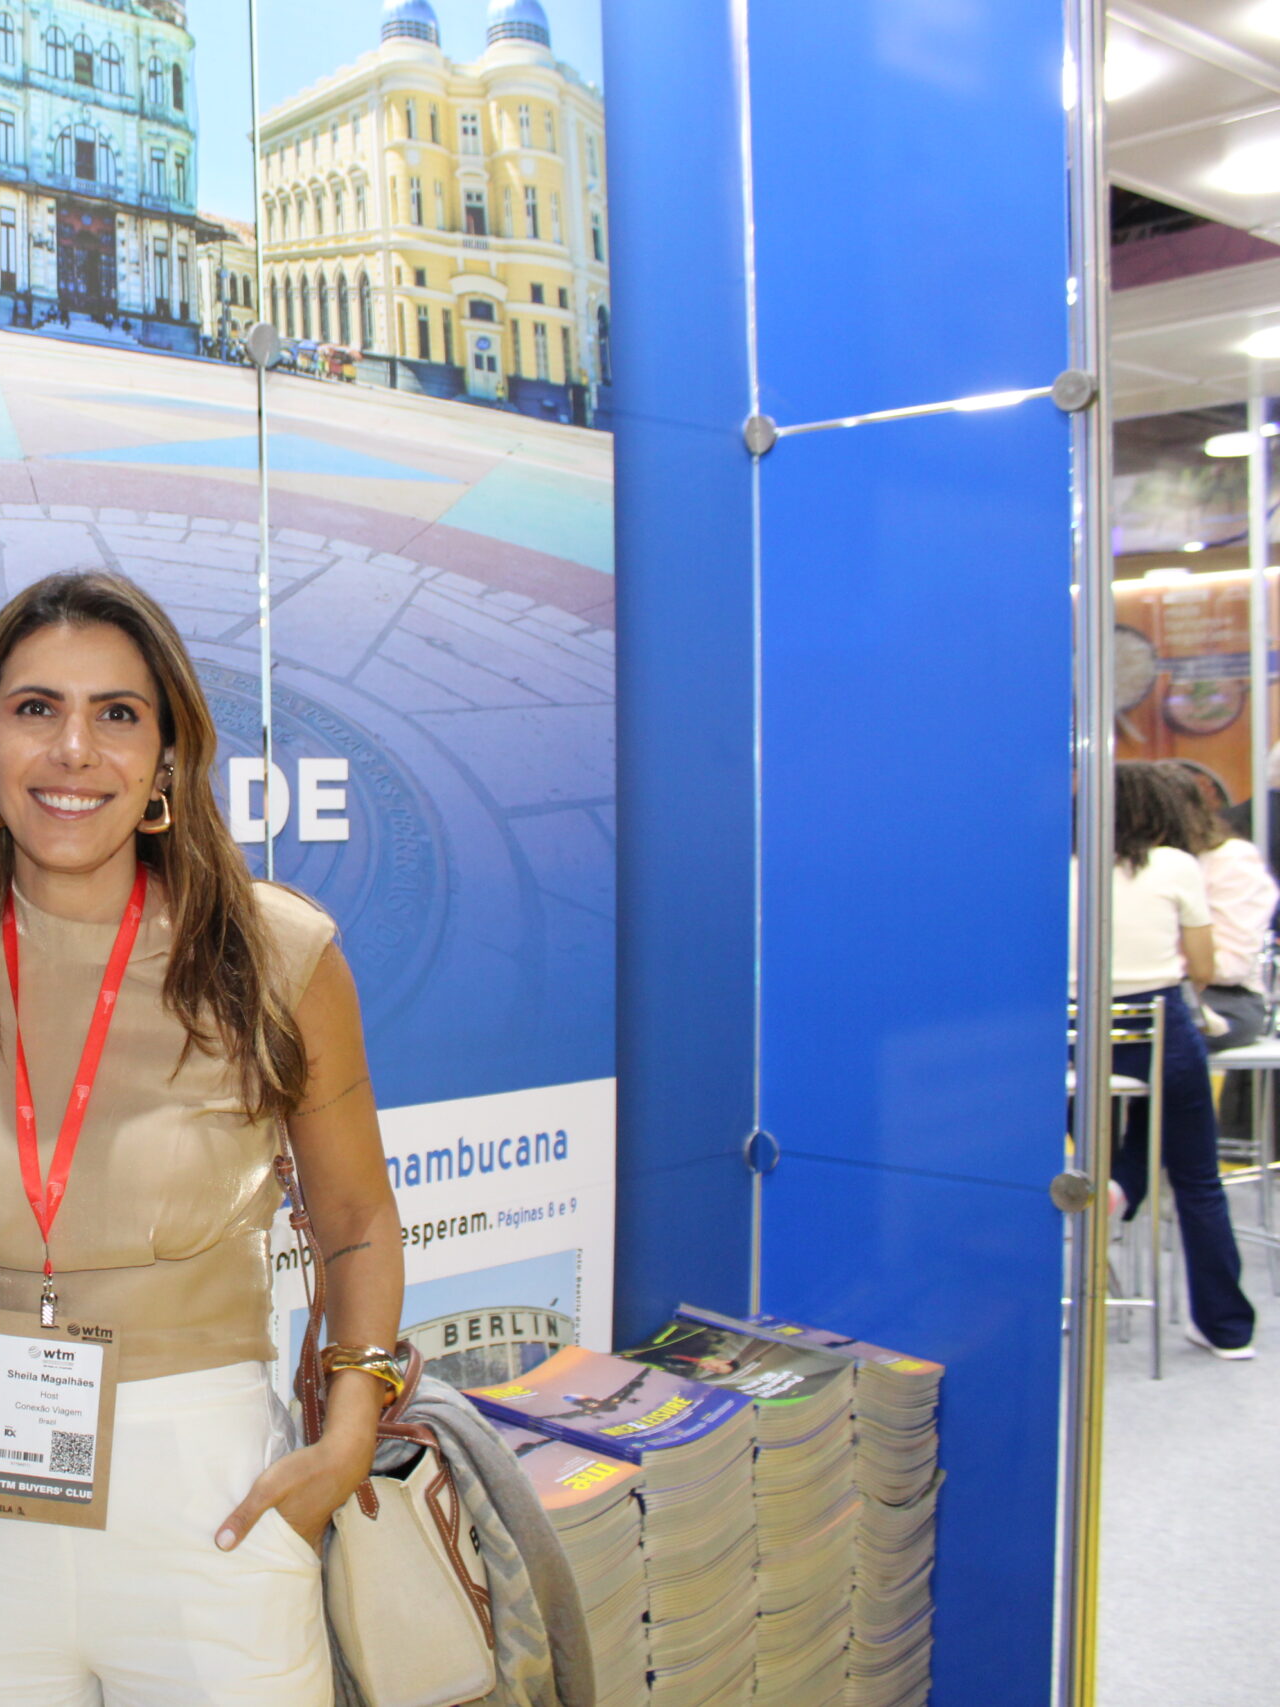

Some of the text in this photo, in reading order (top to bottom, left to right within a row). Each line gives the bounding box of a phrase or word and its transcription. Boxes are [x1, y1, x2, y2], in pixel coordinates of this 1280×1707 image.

[229, 757, 350, 843] DE
[386, 1129, 568, 1188] nambucana
[497, 1206, 544, 1230] Páginas
[548, 1201, 555, 1218] 8
[559, 1203, 566, 1215] e
[570, 1197, 577, 1214] 9
[82, 1325, 113, 1338] wtm
[444, 1315, 559, 1347] BERLIN
[43, 1349, 75, 1361] wtm
[7, 1369, 95, 1388] Sheila Magalhães
[40, 1391, 59, 1400] Host
[15, 1401, 83, 1417] Conexão Viagem
[38, 1417, 57, 1426] Brazil
[18, 1482, 63, 1496] BUYERS'
[65, 1488, 93, 1500] CLUB
